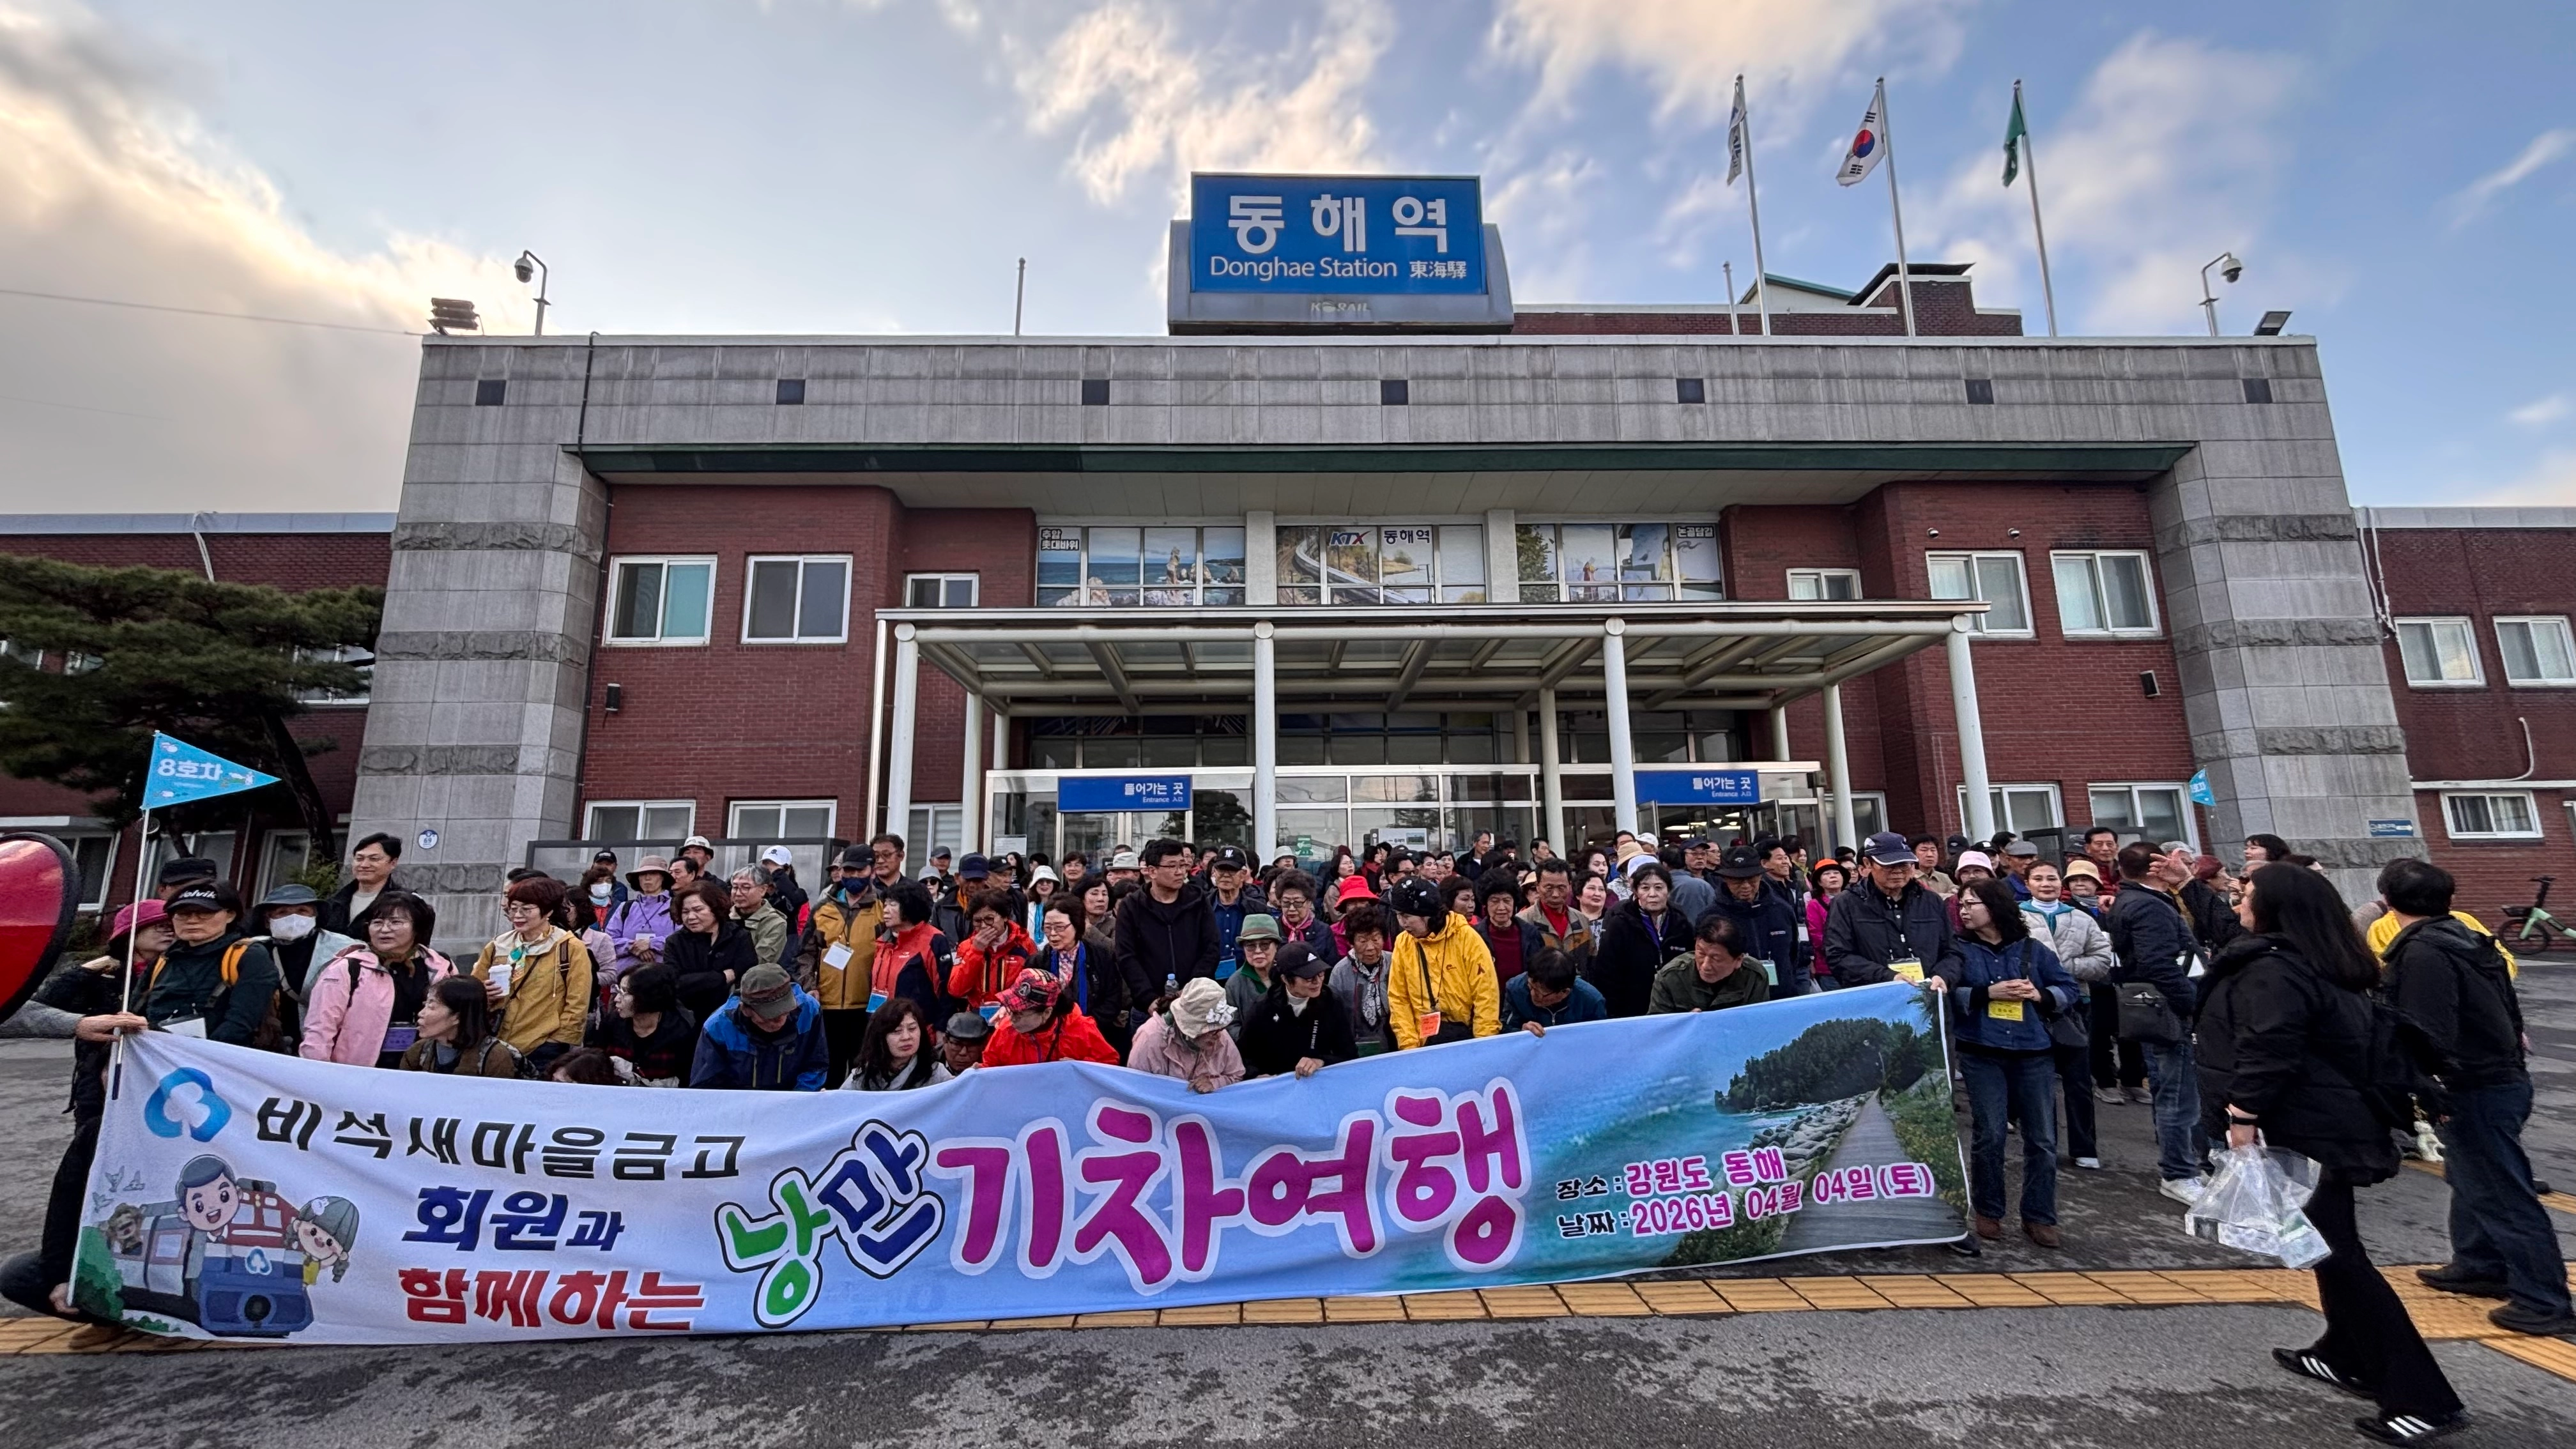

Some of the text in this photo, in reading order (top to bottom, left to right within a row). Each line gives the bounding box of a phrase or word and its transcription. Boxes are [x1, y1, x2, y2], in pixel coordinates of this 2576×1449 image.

[1227, 194, 1448, 254] 동해역
[1211, 256, 1467, 282] Donghae Station 東海驛
[1041, 529, 1062, 540] 추암
[1041, 540, 1078, 550] 촛대바위
[1330, 529, 1430, 546] KTX 동해역
[158, 759, 223, 781] 8호차
[1124, 783, 1184, 795] 들어가는 곳
[1692, 777, 1751, 790] 들어가는 곳
[1724, 1148, 1784, 1184] 동해
[716, 1085, 1524, 1327] 낭만 기차여행
[1747, 1182, 1802, 1218] 04월
[401, 1186, 625, 1252] 회원과
[399, 1268, 705, 1330] 함께하는
